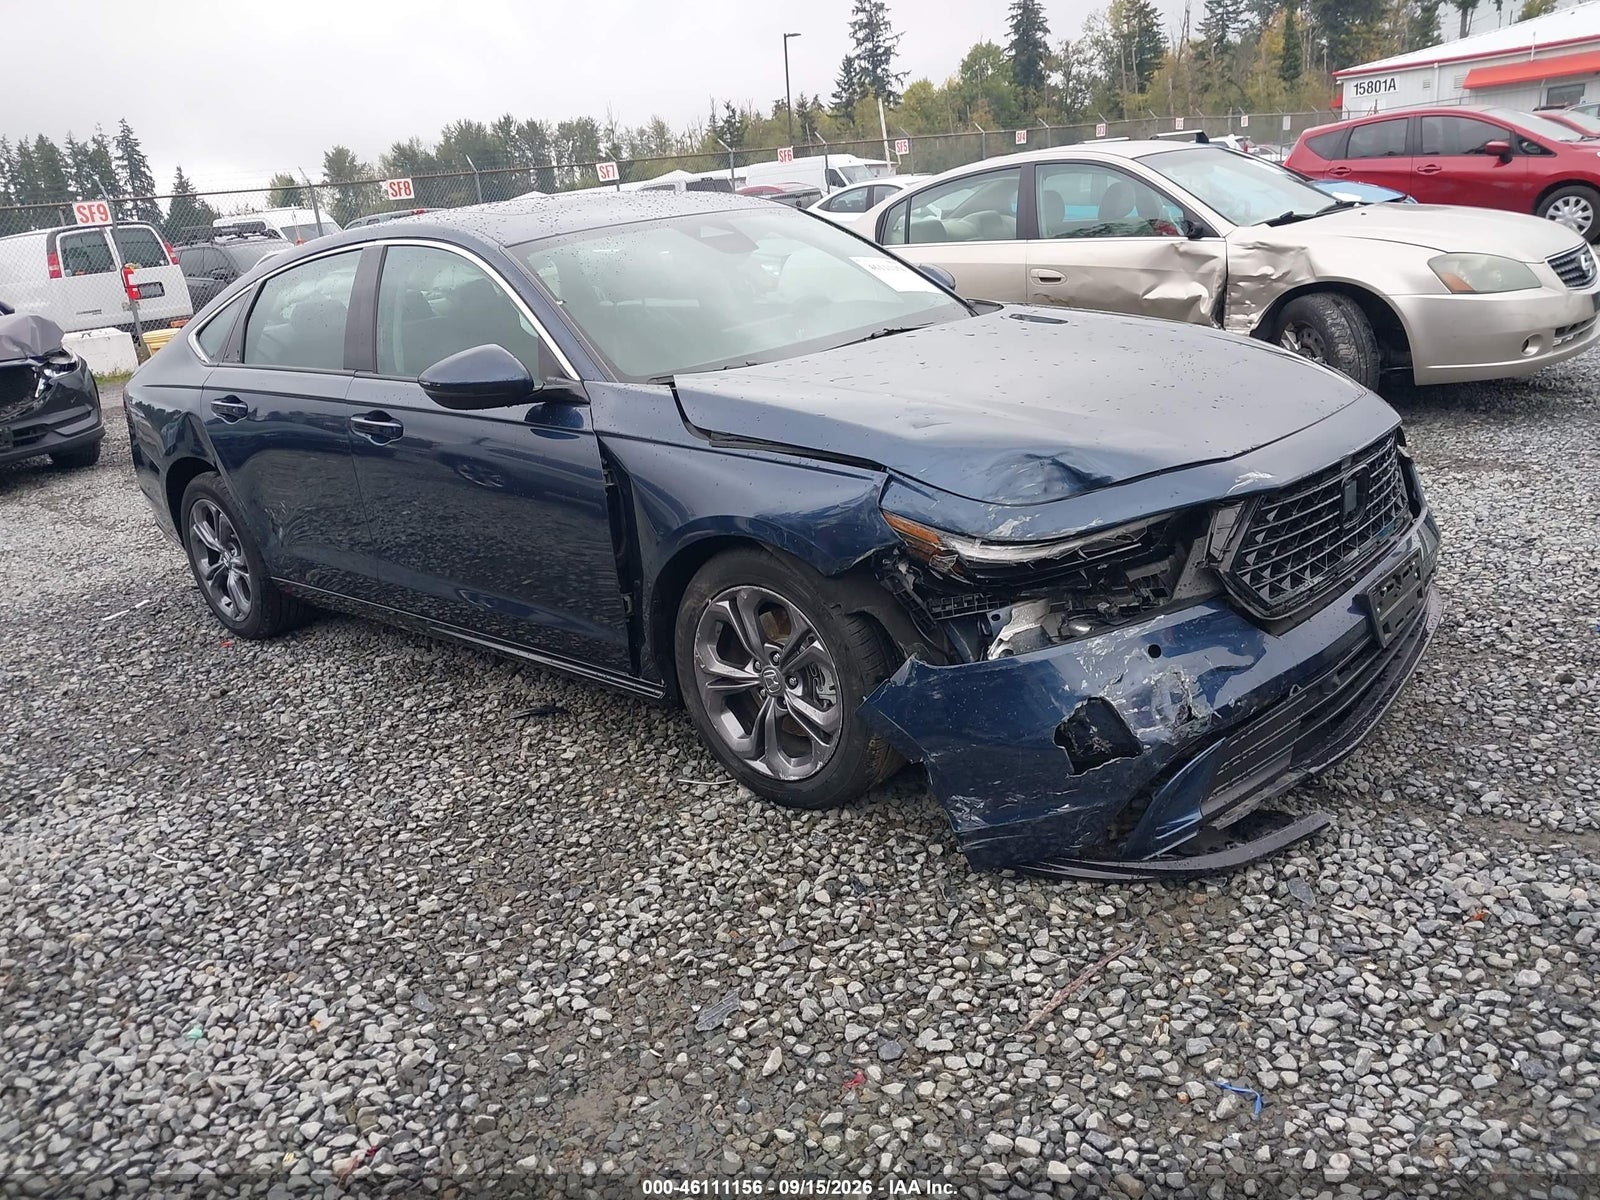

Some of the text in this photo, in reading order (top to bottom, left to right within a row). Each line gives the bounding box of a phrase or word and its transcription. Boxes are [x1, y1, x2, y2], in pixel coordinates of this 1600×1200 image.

[1353, 77, 1396, 96] 15801A
[896, 140, 908, 153] SF5
[778, 149, 793, 163] SF6
[599, 164, 616, 180] SF7
[389, 180, 412, 198] SF8
[76, 203, 109, 224] SF9
